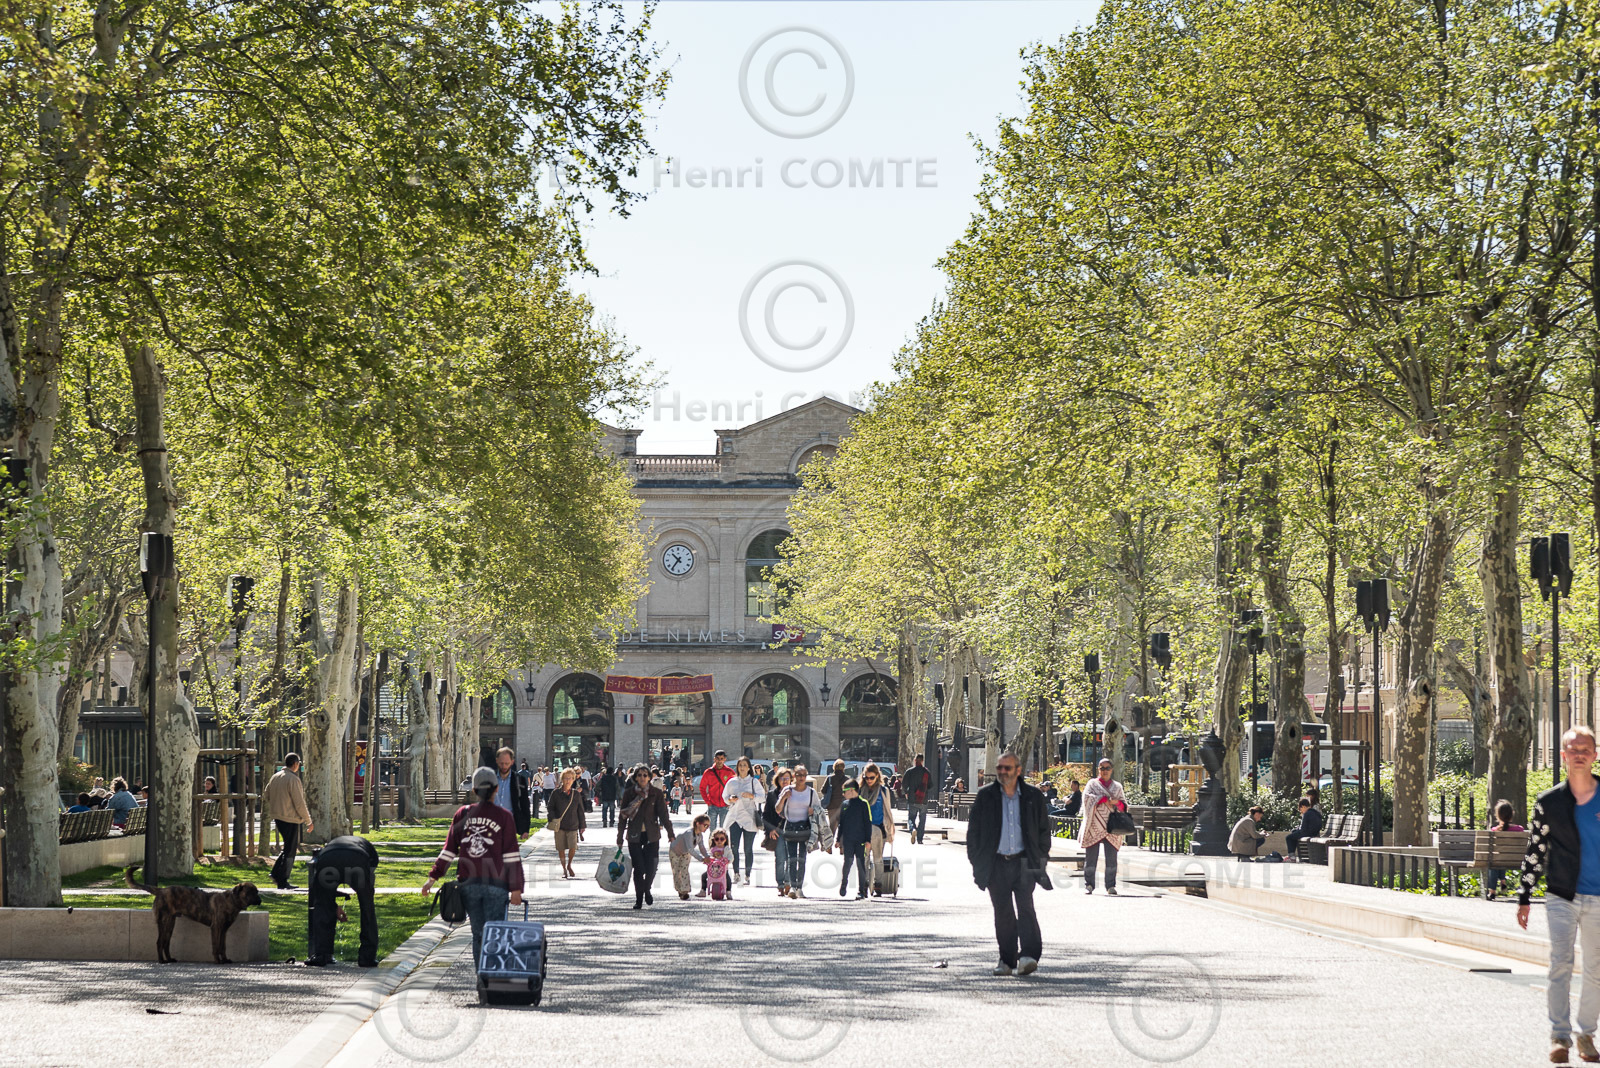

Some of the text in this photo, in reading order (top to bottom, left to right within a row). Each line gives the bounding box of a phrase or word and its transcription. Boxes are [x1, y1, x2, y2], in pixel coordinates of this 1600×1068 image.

[622, 629, 746, 643] DE NIMES
[772, 629, 803, 640] SNCF
[486, 927, 540, 941] BRO
[483, 941, 519, 956] OK
[481, 955, 529, 971] LYN
